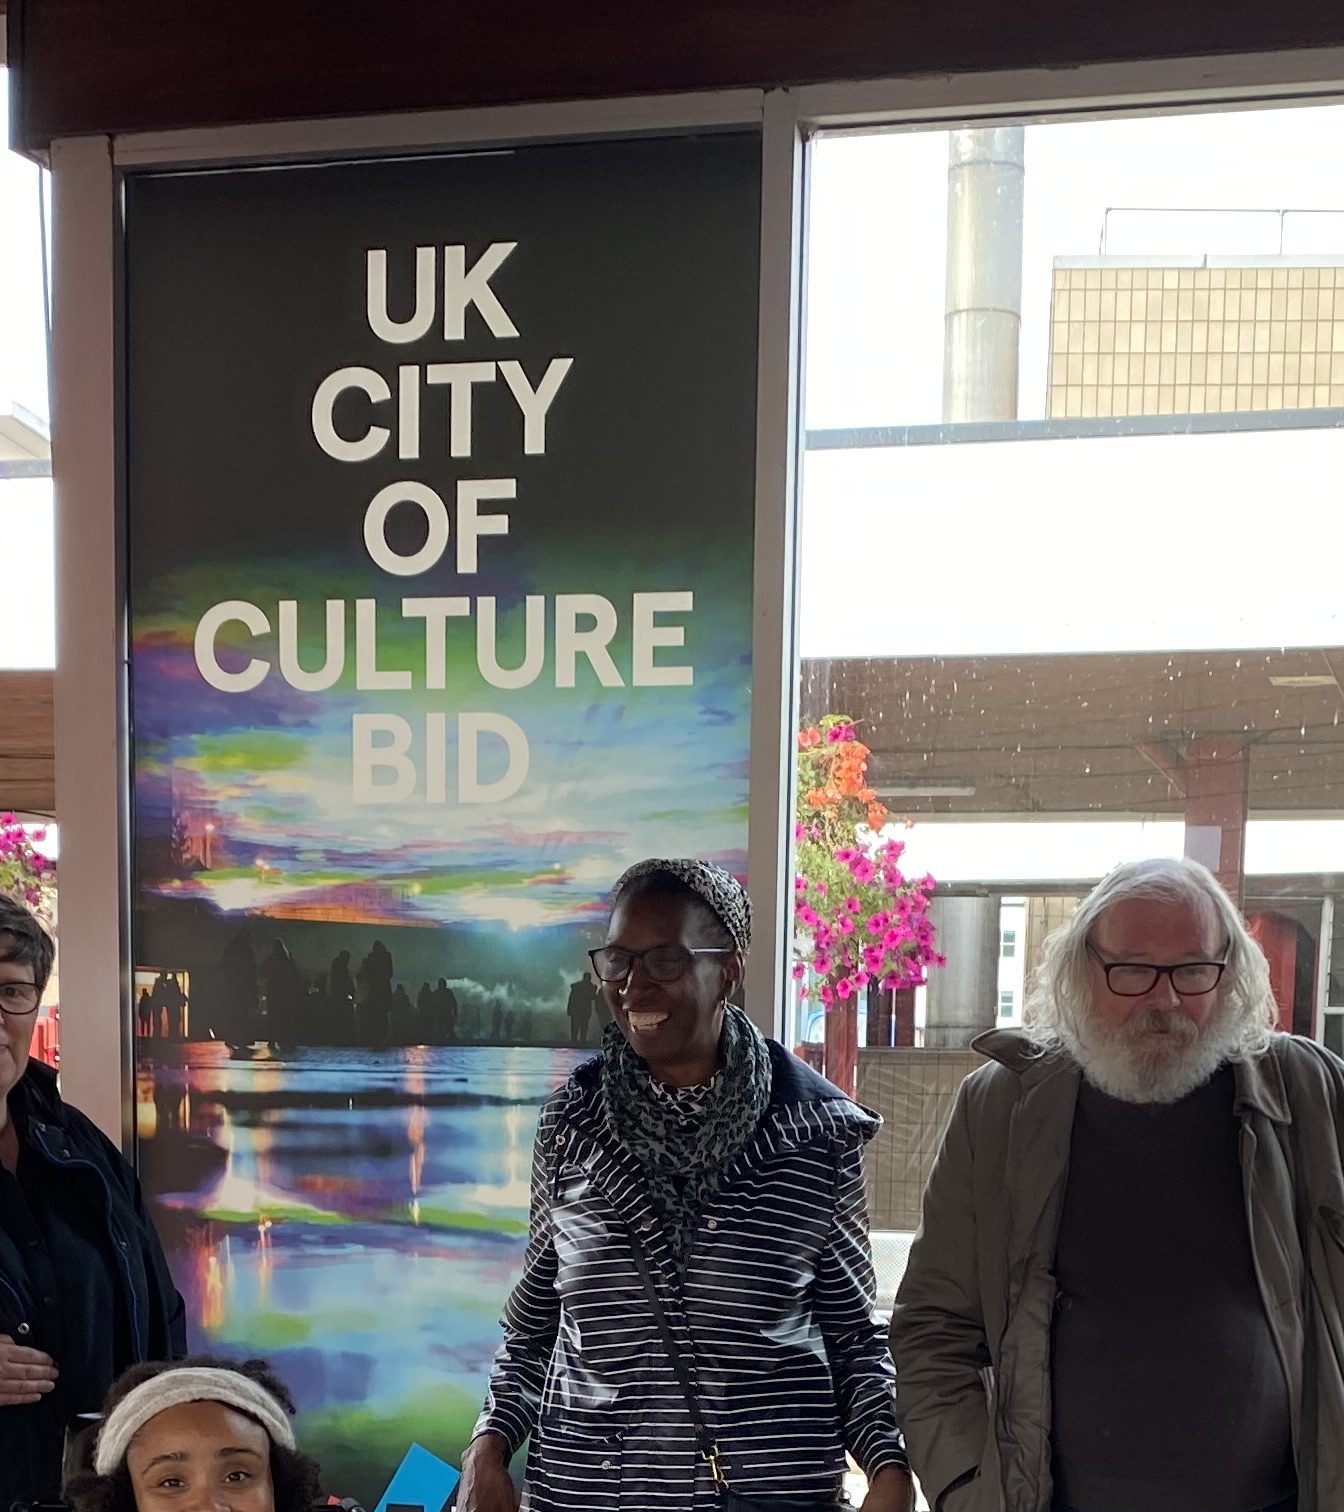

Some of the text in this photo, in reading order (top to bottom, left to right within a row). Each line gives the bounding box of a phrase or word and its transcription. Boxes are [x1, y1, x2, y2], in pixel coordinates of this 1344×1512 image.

[366, 242, 520, 344] UK
[311, 358, 574, 462] CITY
[363, 478, 517, 577] OF
[193, 591, 694, 693] CULTURE
[352, 711, 529, 804] BID
